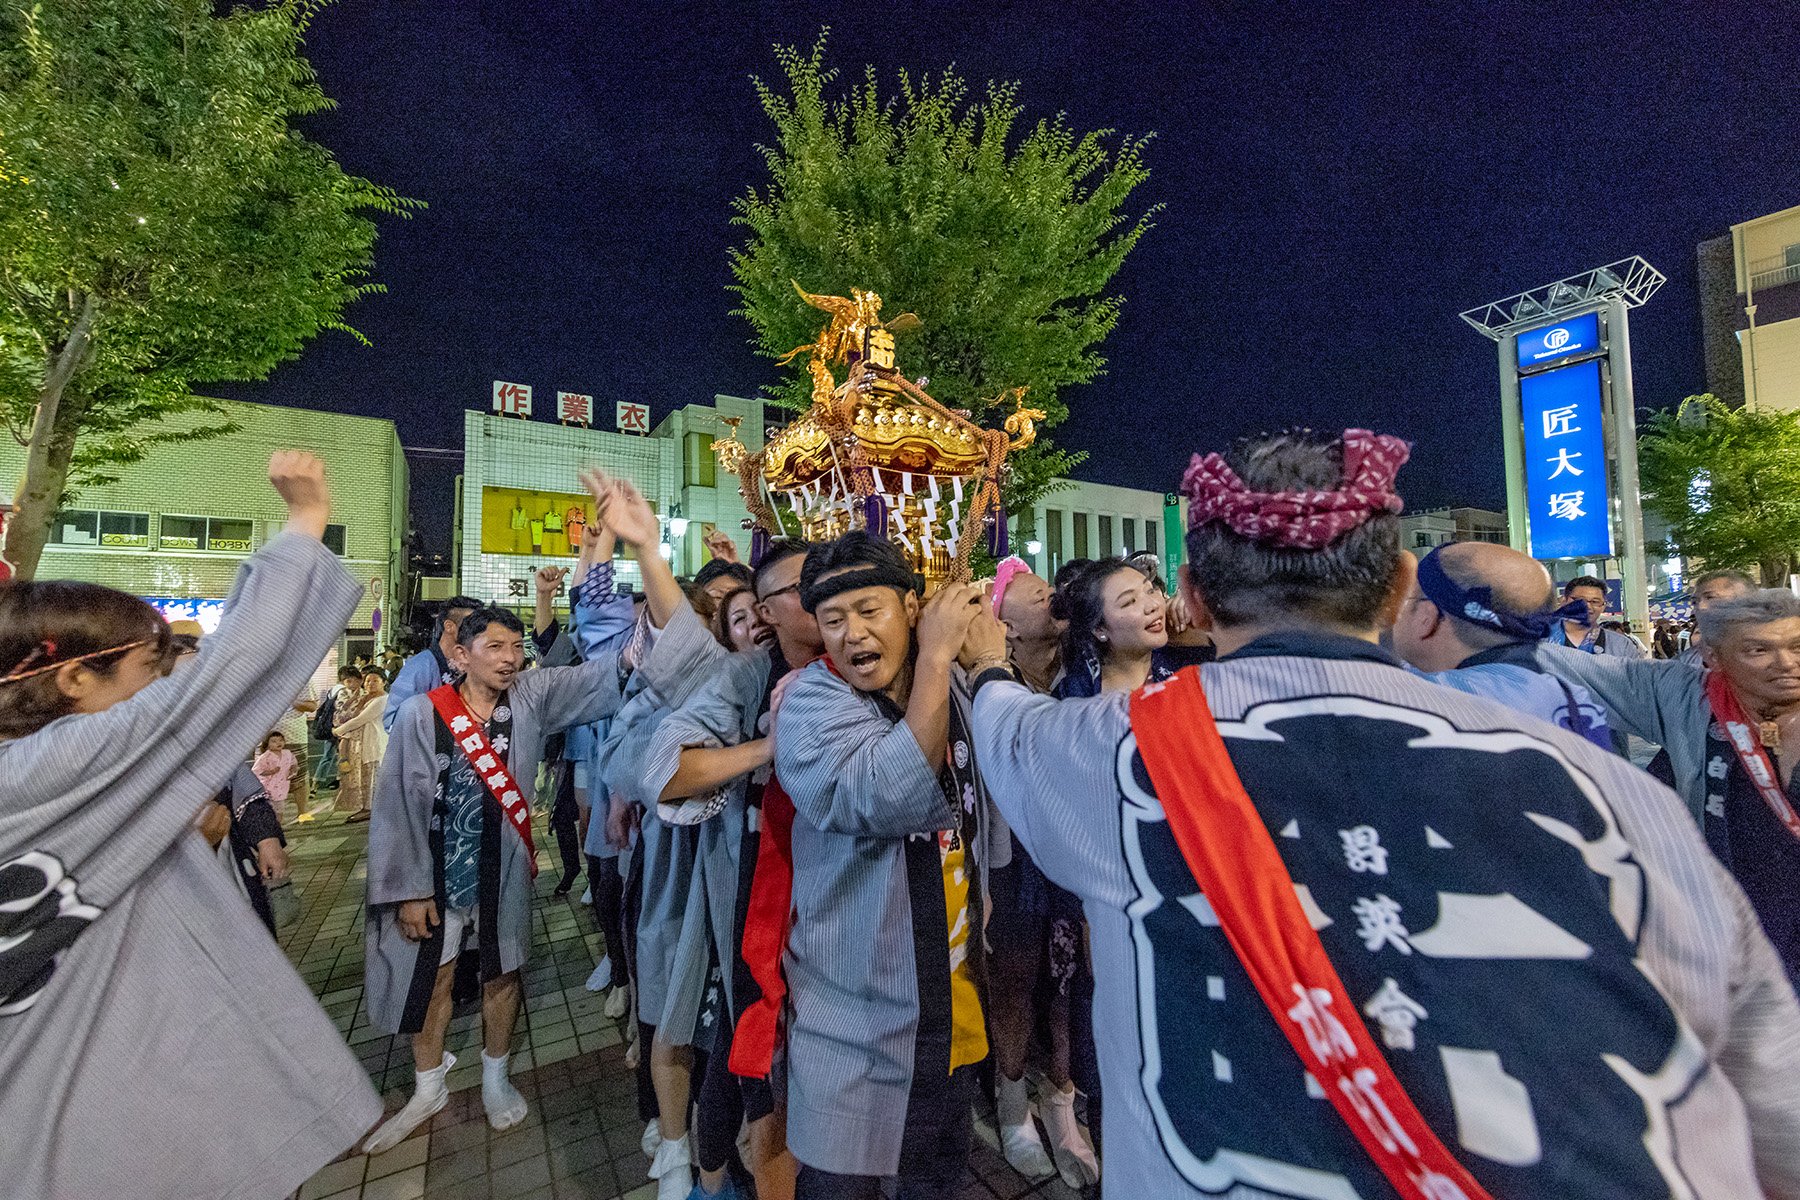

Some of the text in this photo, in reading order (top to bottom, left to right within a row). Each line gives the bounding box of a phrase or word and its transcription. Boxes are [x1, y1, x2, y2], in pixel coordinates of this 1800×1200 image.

[498, 384, 646, 429] 作業衣
[1541, 403, 1587, 521] 匠大塚
[103, 535, 148, 546] COUNT
[210, 540, 251, 549] HOBBY
